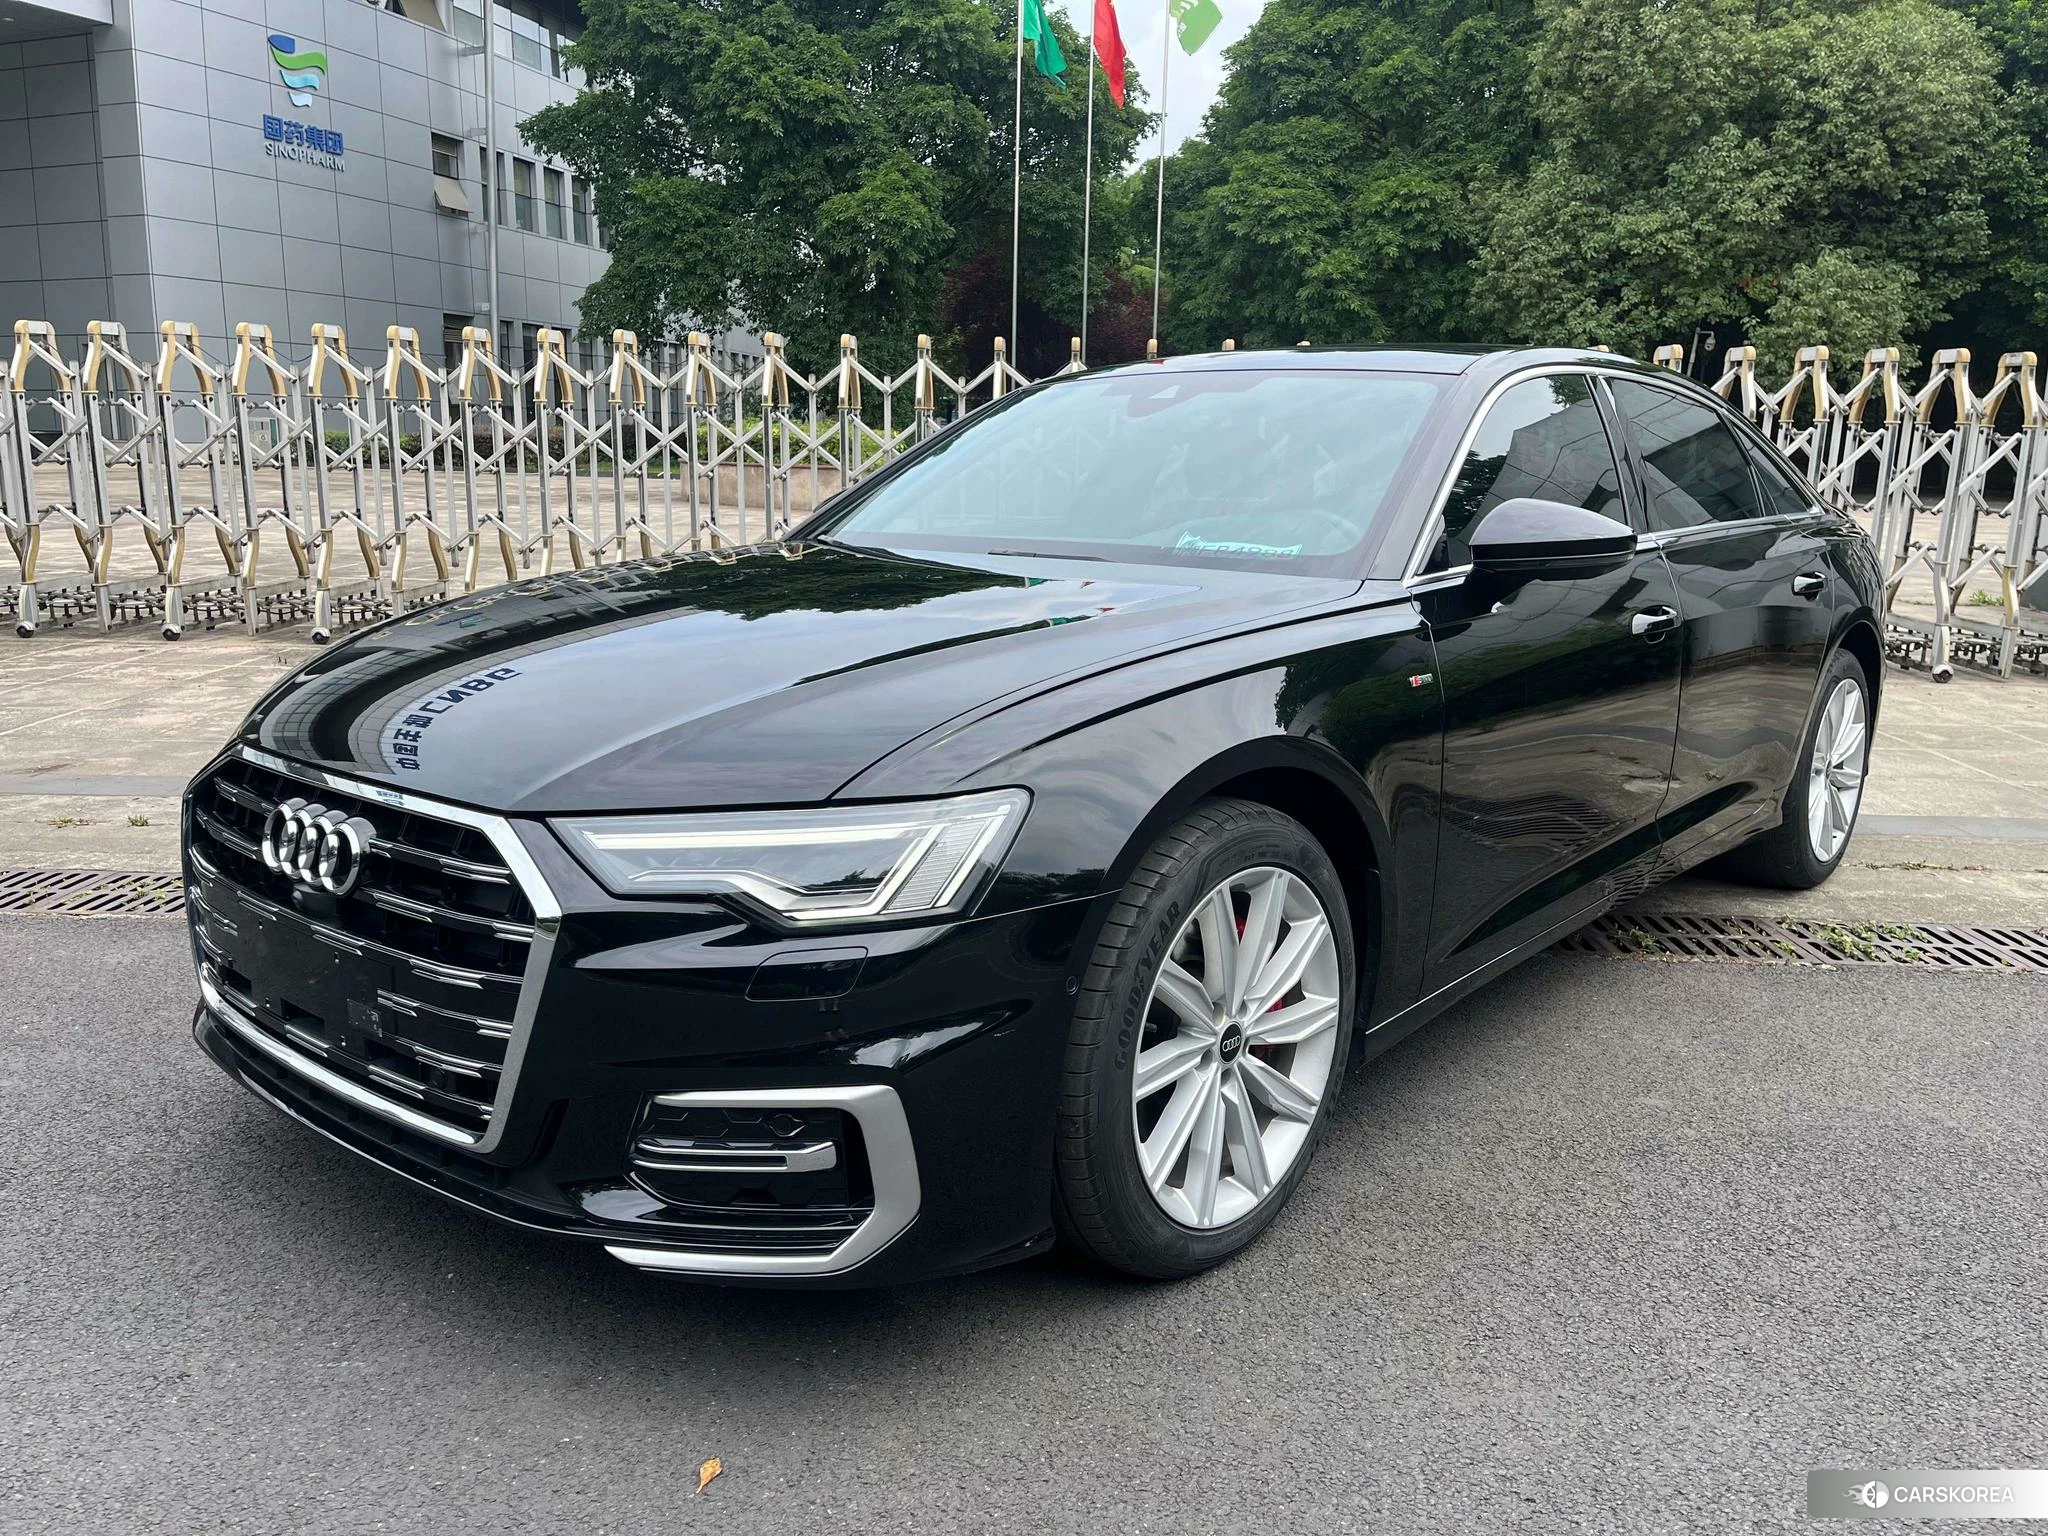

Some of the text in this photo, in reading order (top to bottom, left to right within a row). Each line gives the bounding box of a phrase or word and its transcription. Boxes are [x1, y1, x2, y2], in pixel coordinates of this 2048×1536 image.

[263, 114, 344, 156] 国药集团
[264, 142, 346, 172] SINOPHARM
